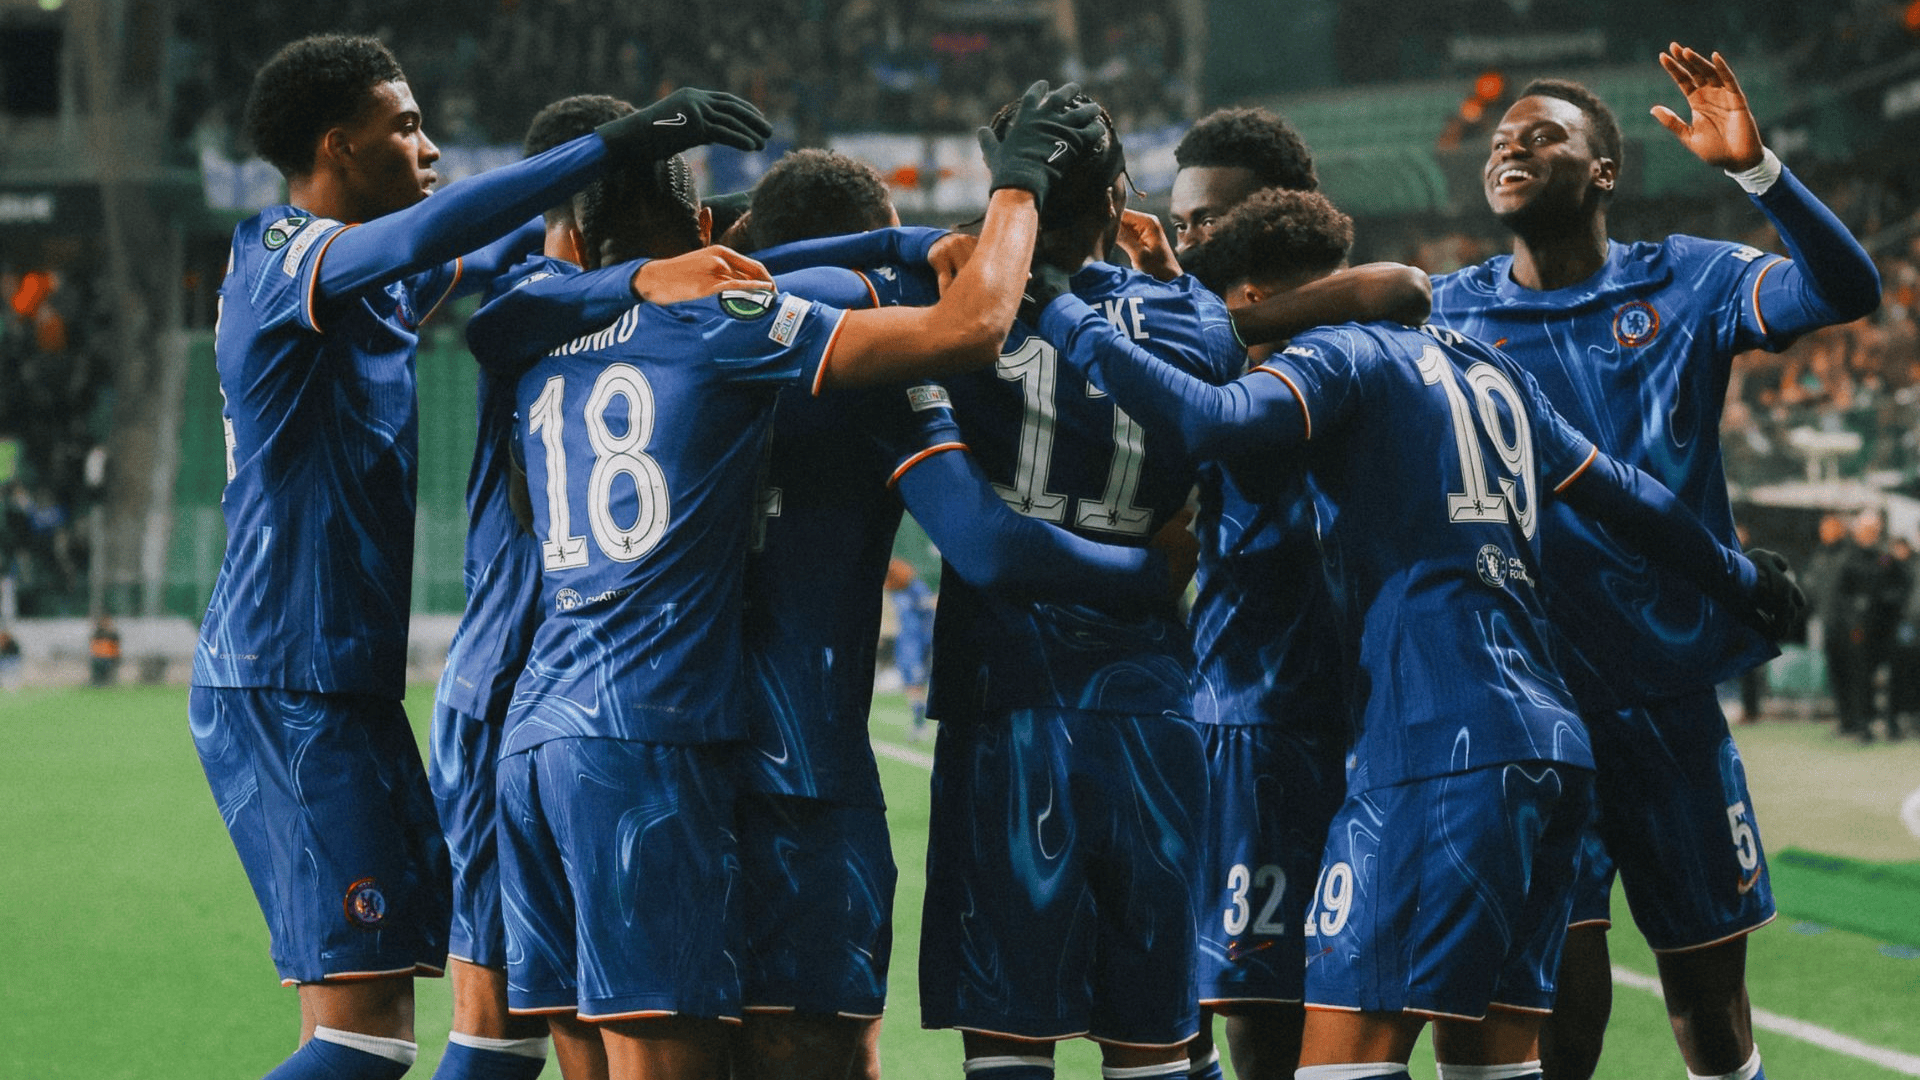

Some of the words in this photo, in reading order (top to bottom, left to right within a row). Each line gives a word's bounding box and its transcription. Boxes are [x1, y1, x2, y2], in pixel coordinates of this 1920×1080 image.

[1091, 297, 1149, 339] KE
[529, 362, 670, 572] 18
[996, 336, 1154, 536] 11
[1416, 345, 1537, 541] 19
[1223, 863, 1286, 936] 32
[1727, 801, 1757, 870] 5
